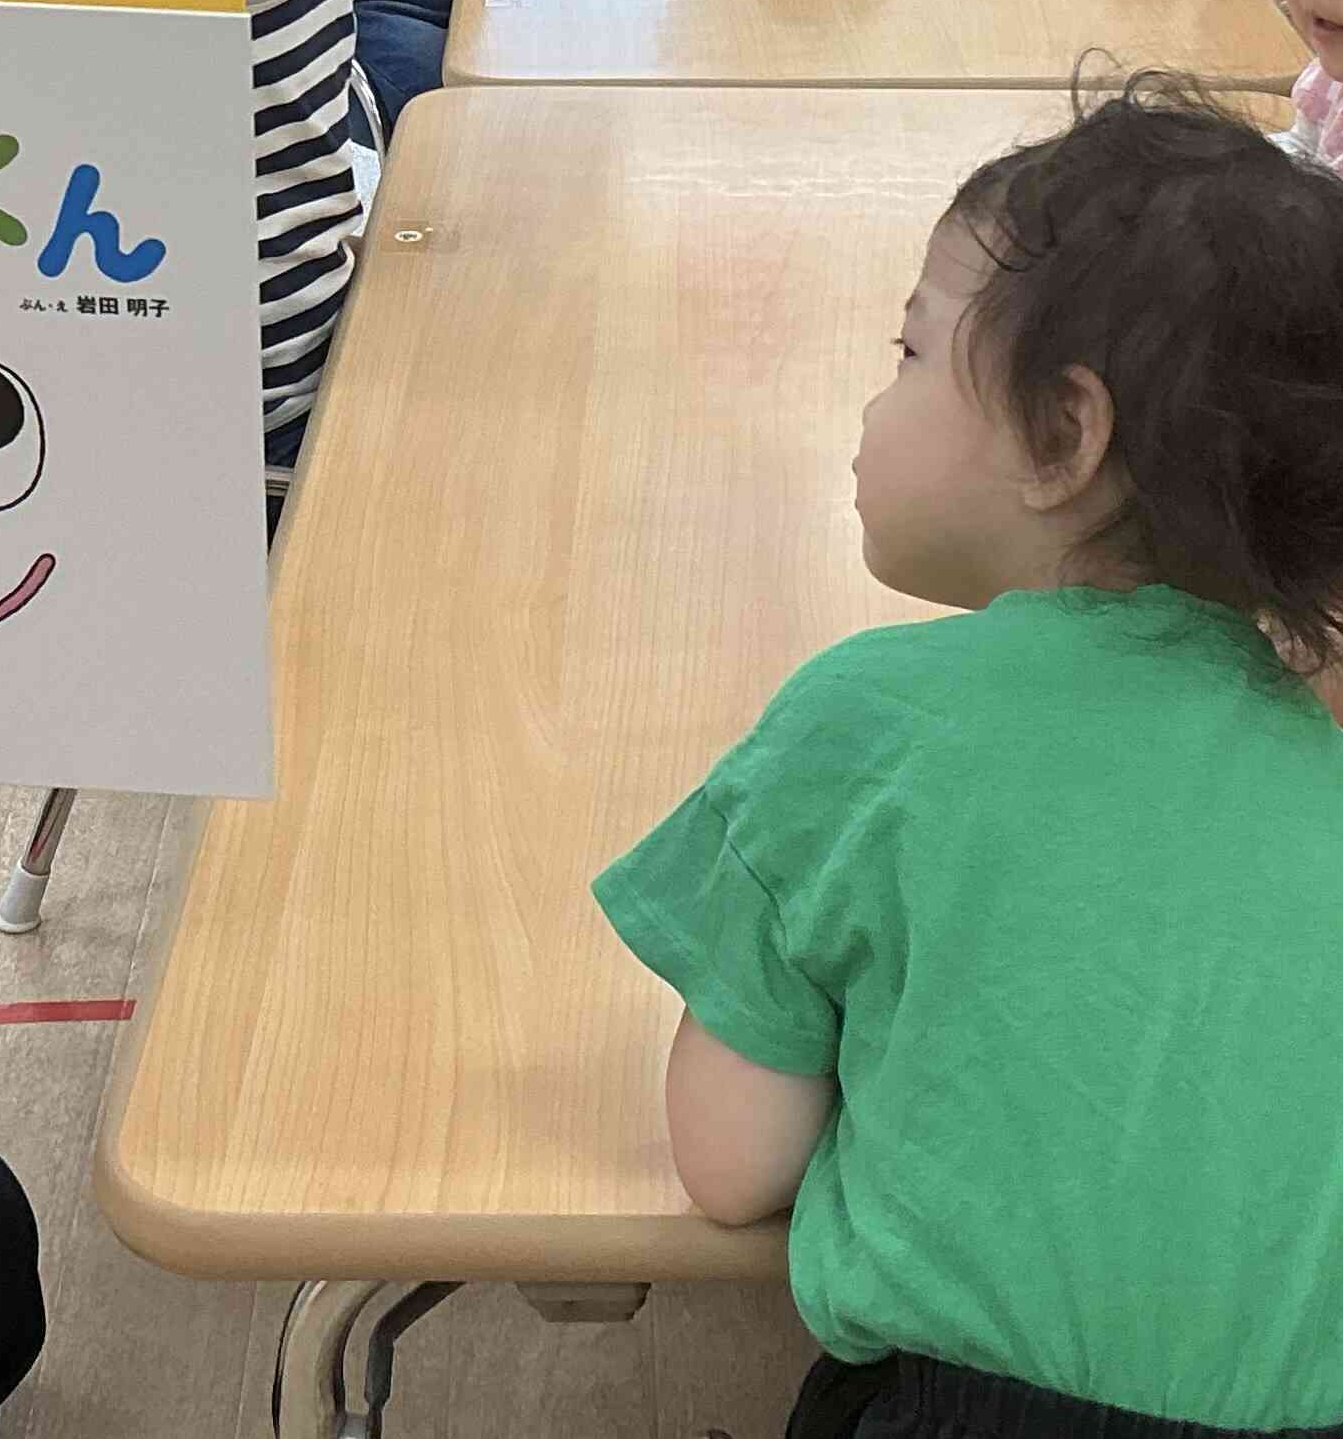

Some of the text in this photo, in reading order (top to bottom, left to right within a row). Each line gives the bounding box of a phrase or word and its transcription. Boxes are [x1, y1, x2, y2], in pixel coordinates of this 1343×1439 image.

[18, 295, 170, 318] ぶん・え 岩田 明子
